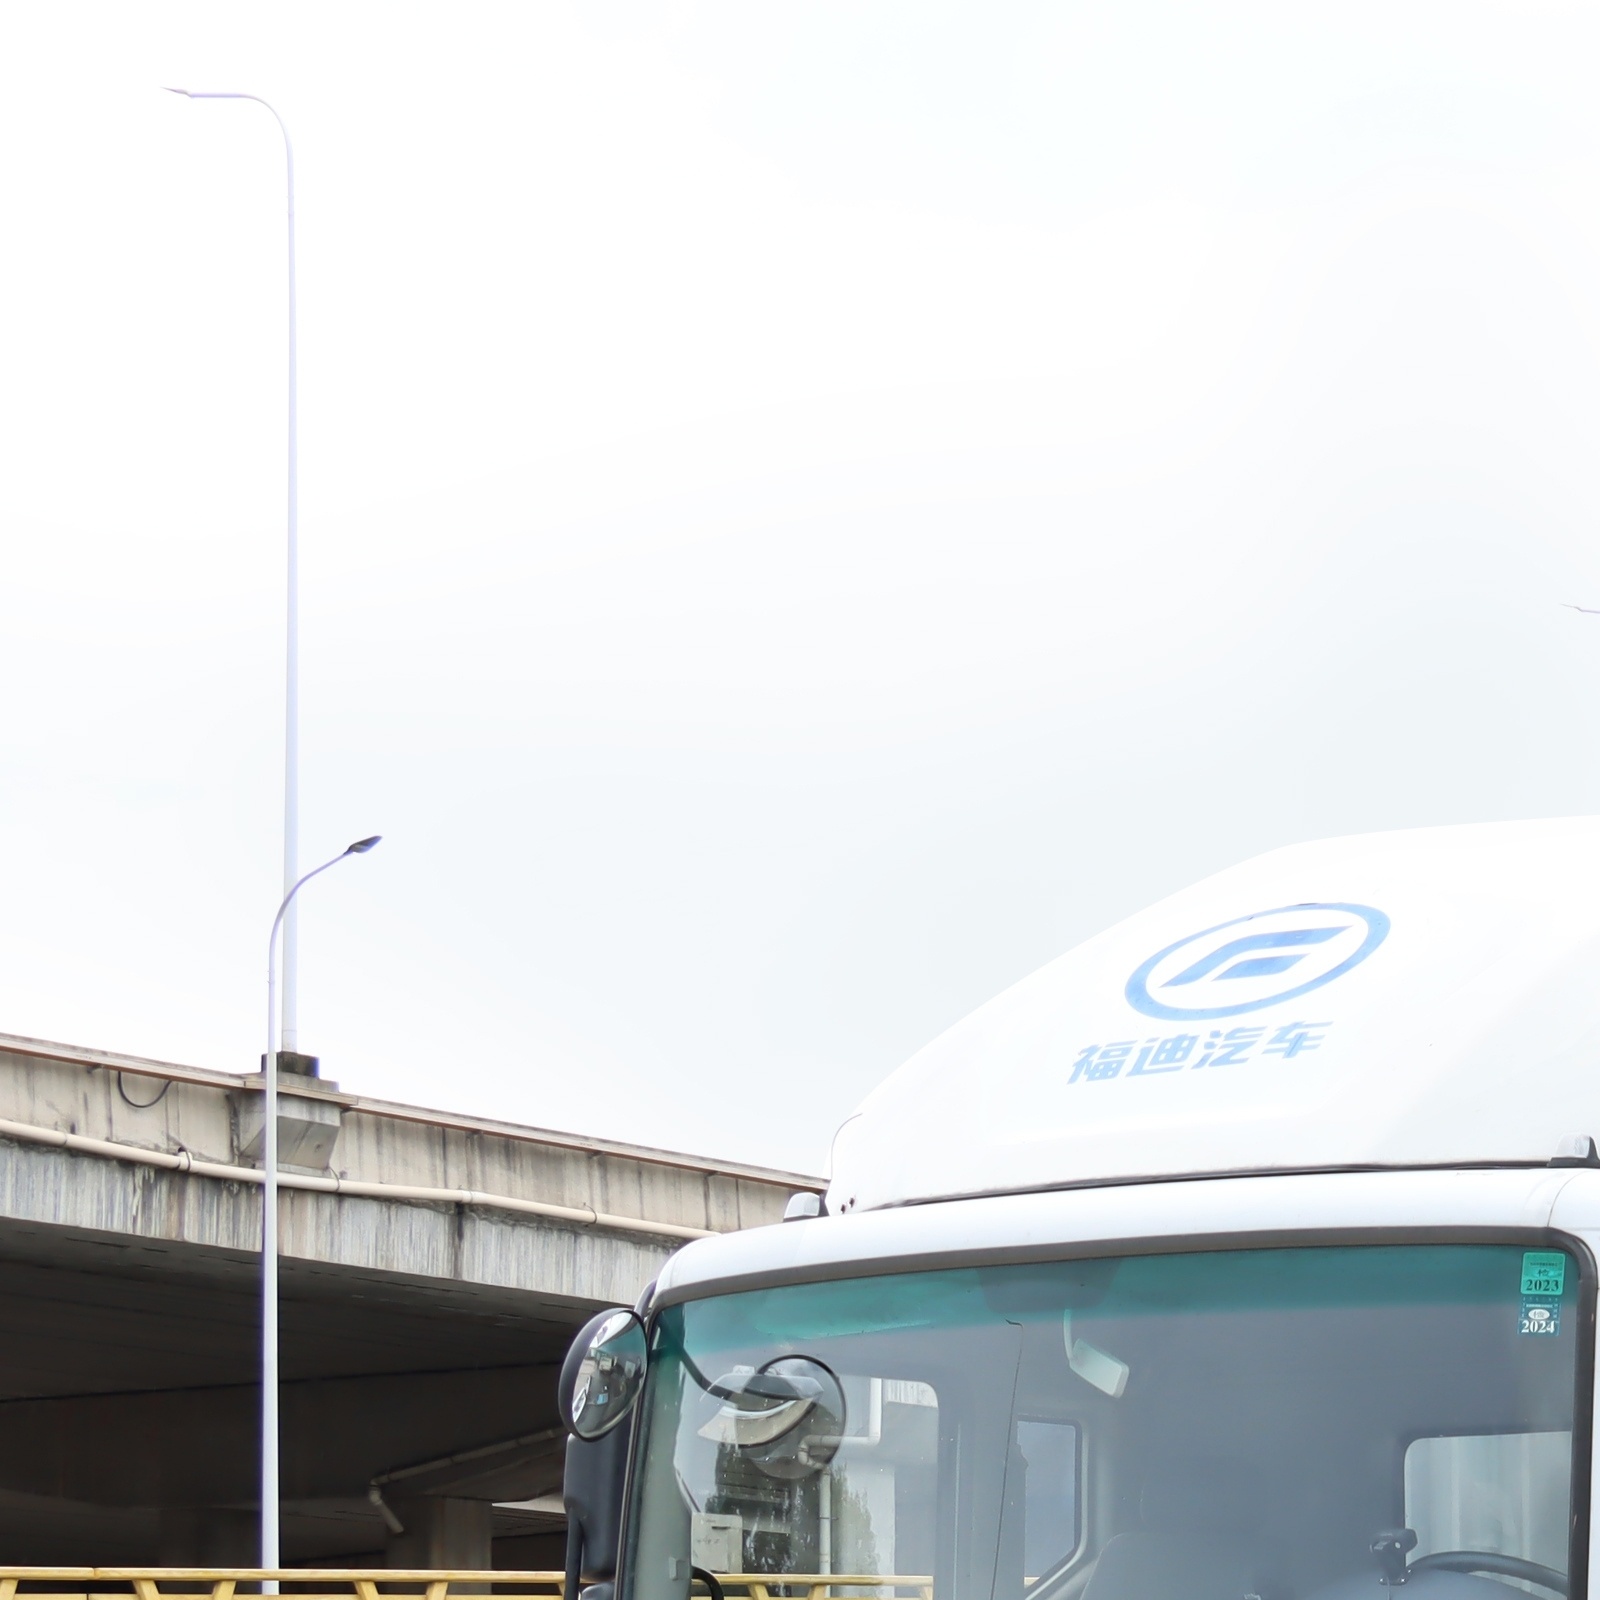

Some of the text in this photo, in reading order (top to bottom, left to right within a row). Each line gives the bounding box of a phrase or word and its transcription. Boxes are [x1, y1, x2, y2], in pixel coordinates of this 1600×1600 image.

[1066, 1021, 1333, 1085] 福迪汽车
[1525, 1279, 1559, 1292] 2023
[1521, 1320, 1555, 1334] 2024
